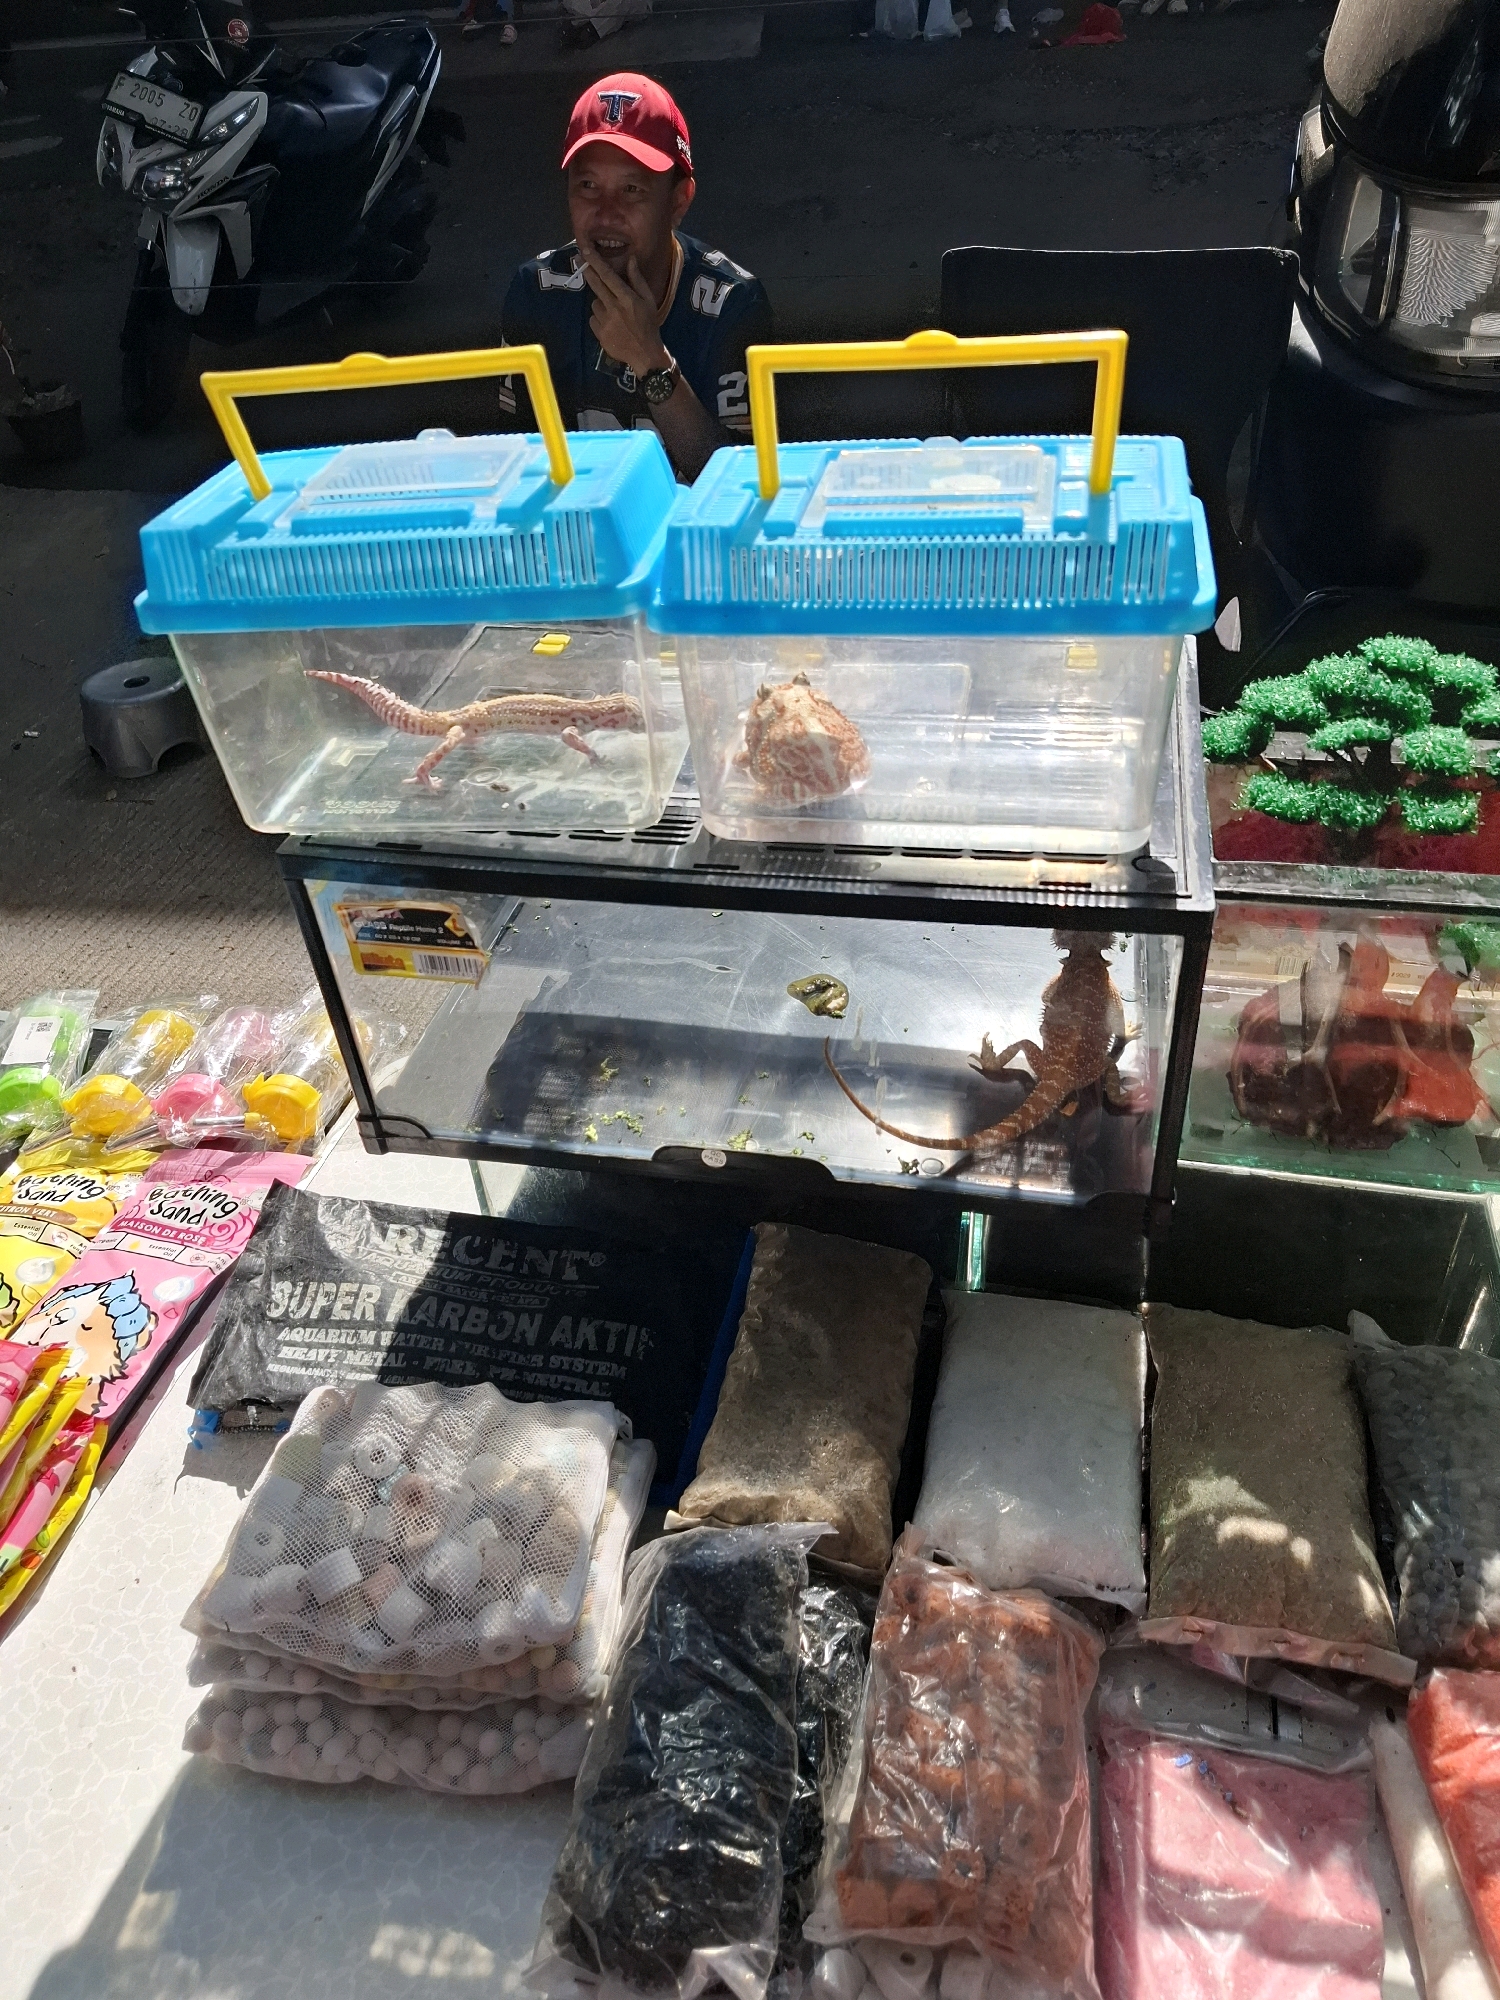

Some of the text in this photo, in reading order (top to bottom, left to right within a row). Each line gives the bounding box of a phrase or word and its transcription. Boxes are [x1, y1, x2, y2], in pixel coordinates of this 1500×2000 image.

[114, 76, 126, 91] F
[129, 83, 166, 108] 2005
[105, 104, 125, 117] YAMAHA
[597, 90, 643, 124] T
[197, 175, 230, 201] HONDA
[354, 921, 388, 930] GLASS
[438, 926, 444, 934] 2
[704, 1154, 724, 1165] PASS
[711, 1150, 722, 1158] QC
[17, 1173, 105, 1199] Bathing
[17, 1185, 74, 1203] Sand
[0, 1205, 58, 1218] ITRON VERT
[149, 1185, 239, 1219] Bathing
[150, 1200, 208, 1226] Sand
[13, 1222, 41, 1232] Essential
[118, 1220, 207, 1244] MAISON DE ROSE
[148, 1244, 177, 1253] Essential
[361, 1252, 474, 1283] AQUARIUM
[266, 1280, 381, 1321] SUPER
[387, 1290, 543, 1347] KARBON
[276, 1326, 377, 1345] AQUARIUM
[380, 1331, 445, 1352] WATER
[548, 1355, 628, 1381] SYSTEM
[276, 1346, 338, 1364] HEAVY
[342, 1350, 406, 1368] METAL
